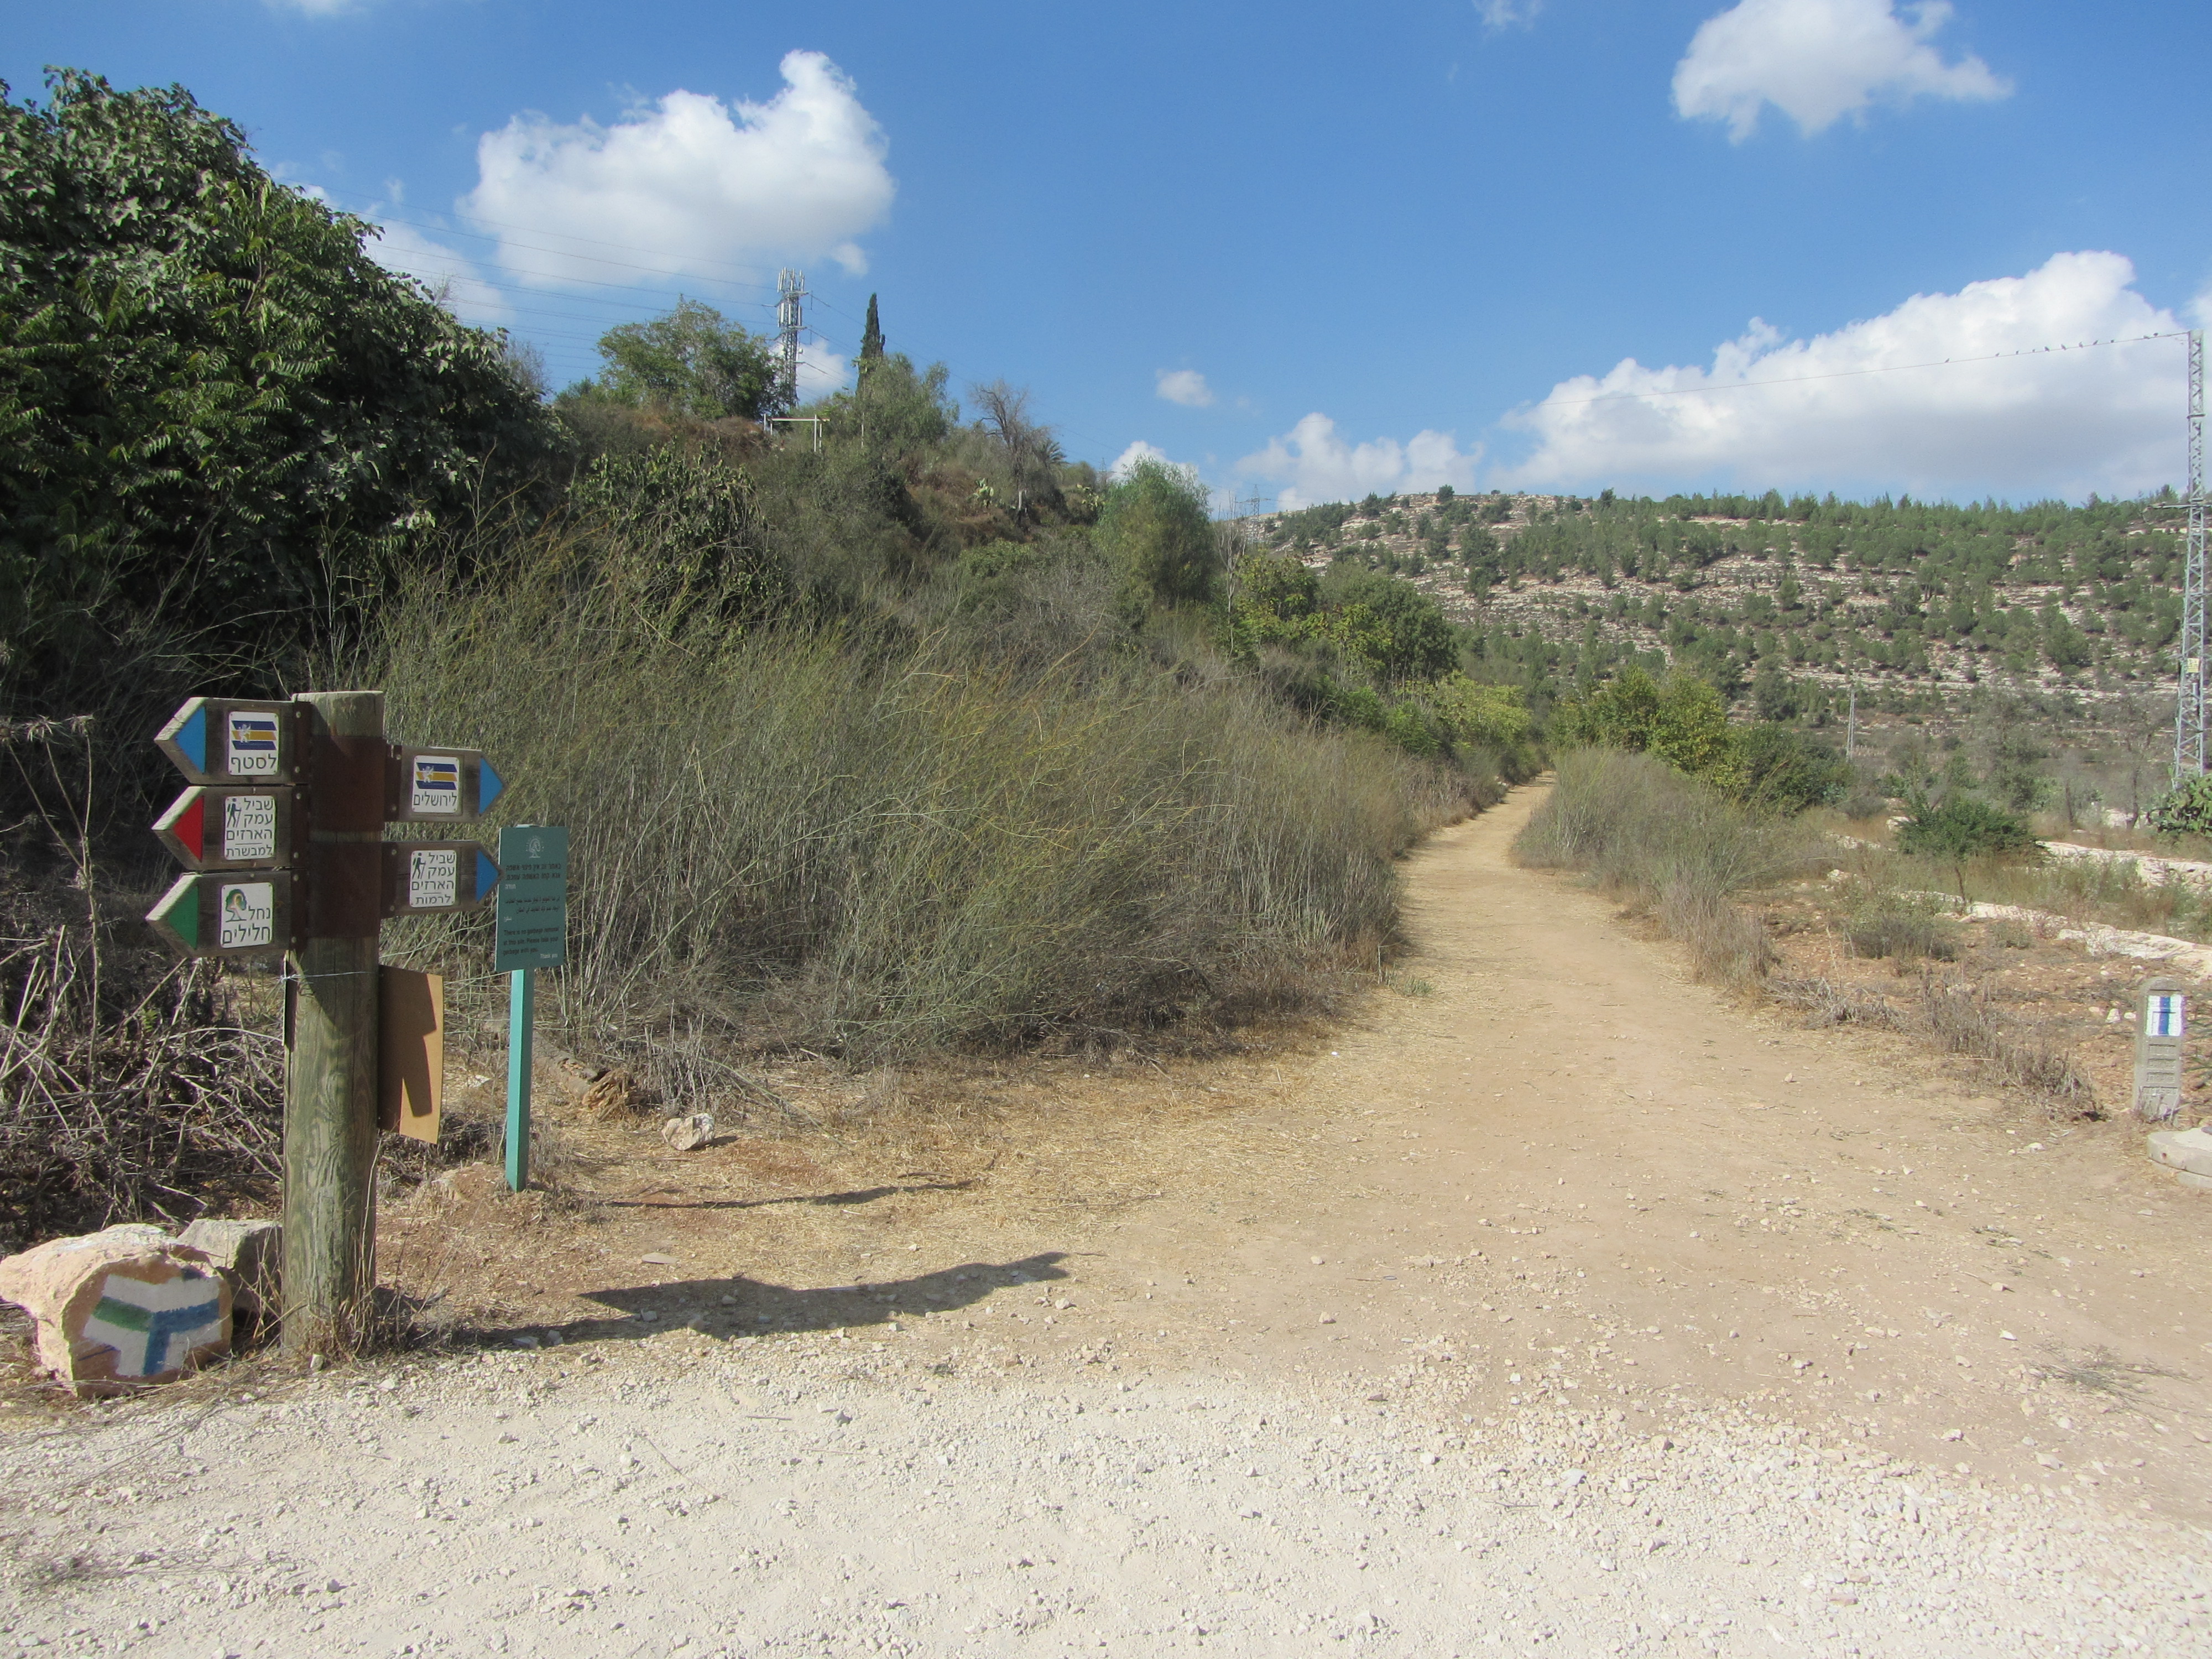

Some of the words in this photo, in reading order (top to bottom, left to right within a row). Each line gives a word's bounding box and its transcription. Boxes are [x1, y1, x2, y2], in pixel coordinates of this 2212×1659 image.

[231, 753, 276, 773] לסטף
[243, 797, 274, 811] שביל
[413, 791, 457, 807] לירושלים
[244, 813, 273, 828] עמק
[226, 830, 272, 841] הארזים
[226, 844, 272, 857] למבשרת
[428, 852, 455, 864] שביל
[428, 867, 455, 879] עמק
[411, 880, 454, 890] הארזים
[415, 894, 451, 904] לרמות
[248, 905, 270, 920] נחל
[222, 923, 270, 944] חלילים
